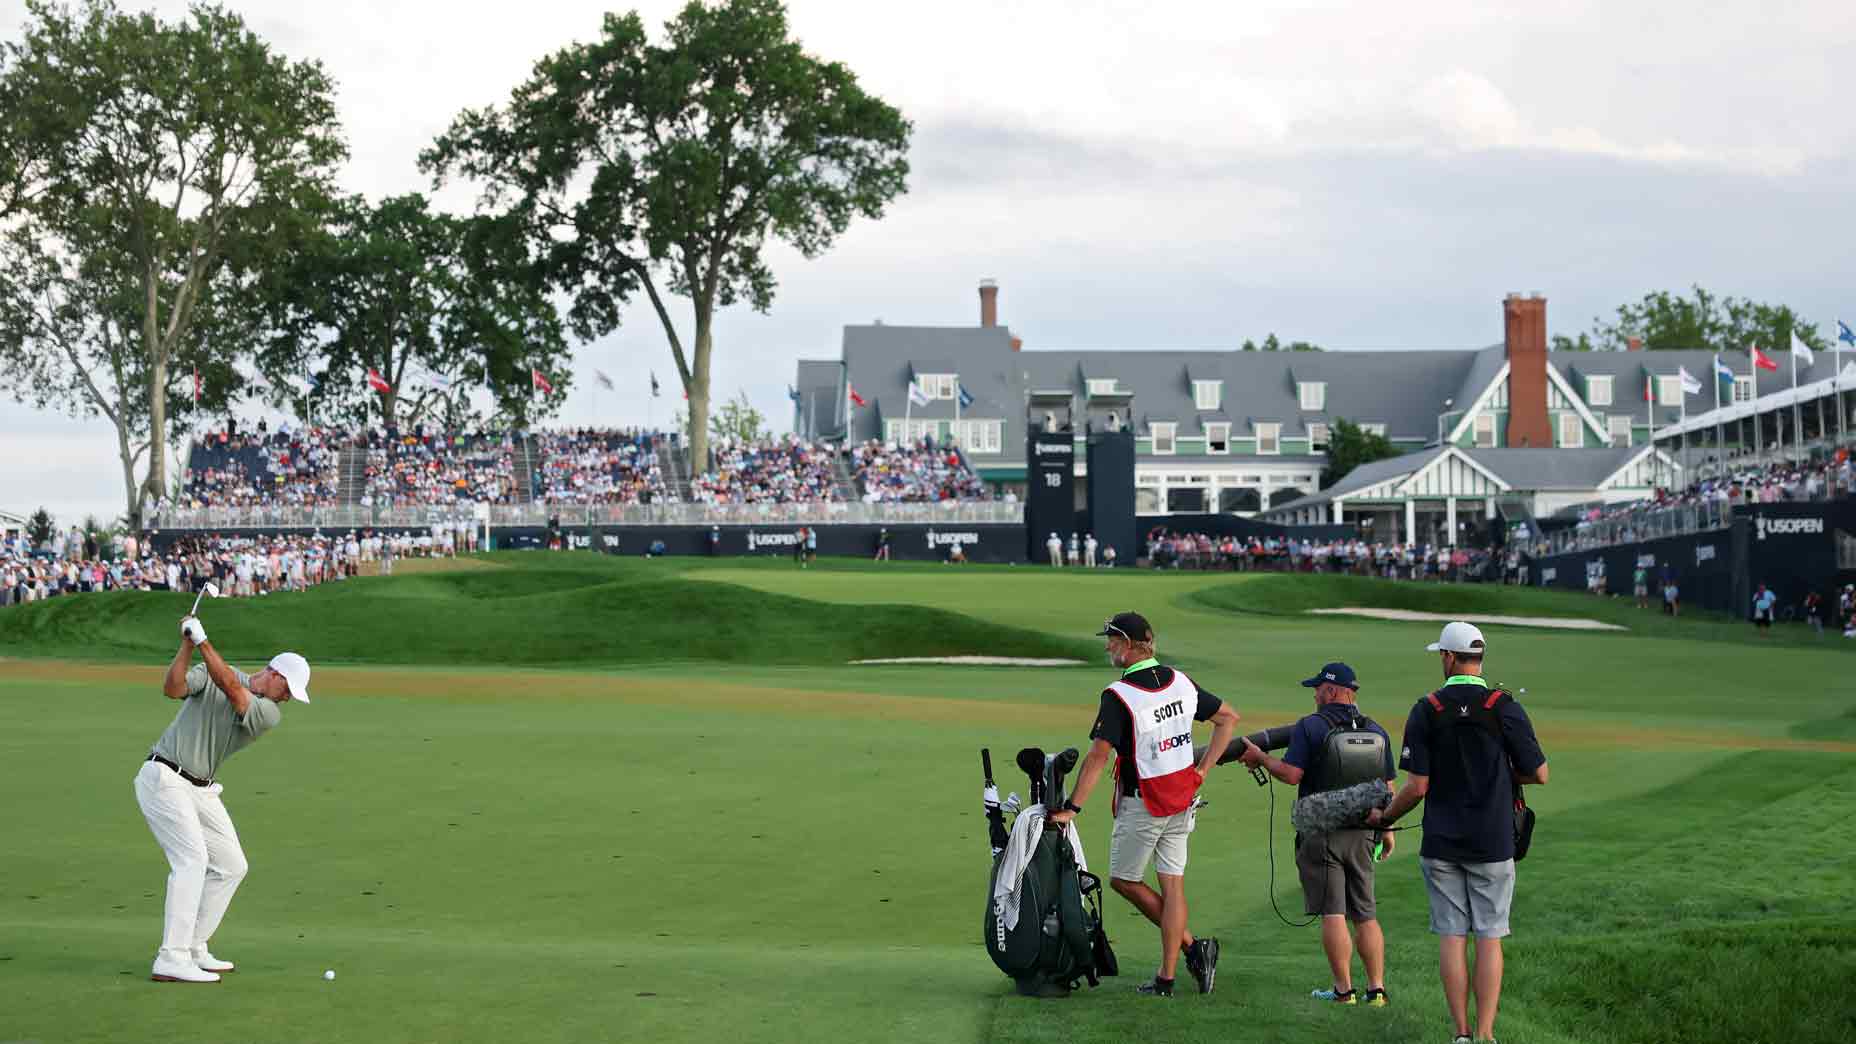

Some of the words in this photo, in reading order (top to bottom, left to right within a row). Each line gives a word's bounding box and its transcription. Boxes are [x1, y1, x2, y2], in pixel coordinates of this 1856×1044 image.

[1045, 473, 1061, 487] 18
[1767, 518, 1823, 533] USOPEN
[936, 533, 978, 544] USOPEN
[1154, 700, 1183, 723] SCOTT
[1159, 732, 1191, 752] USOPE
